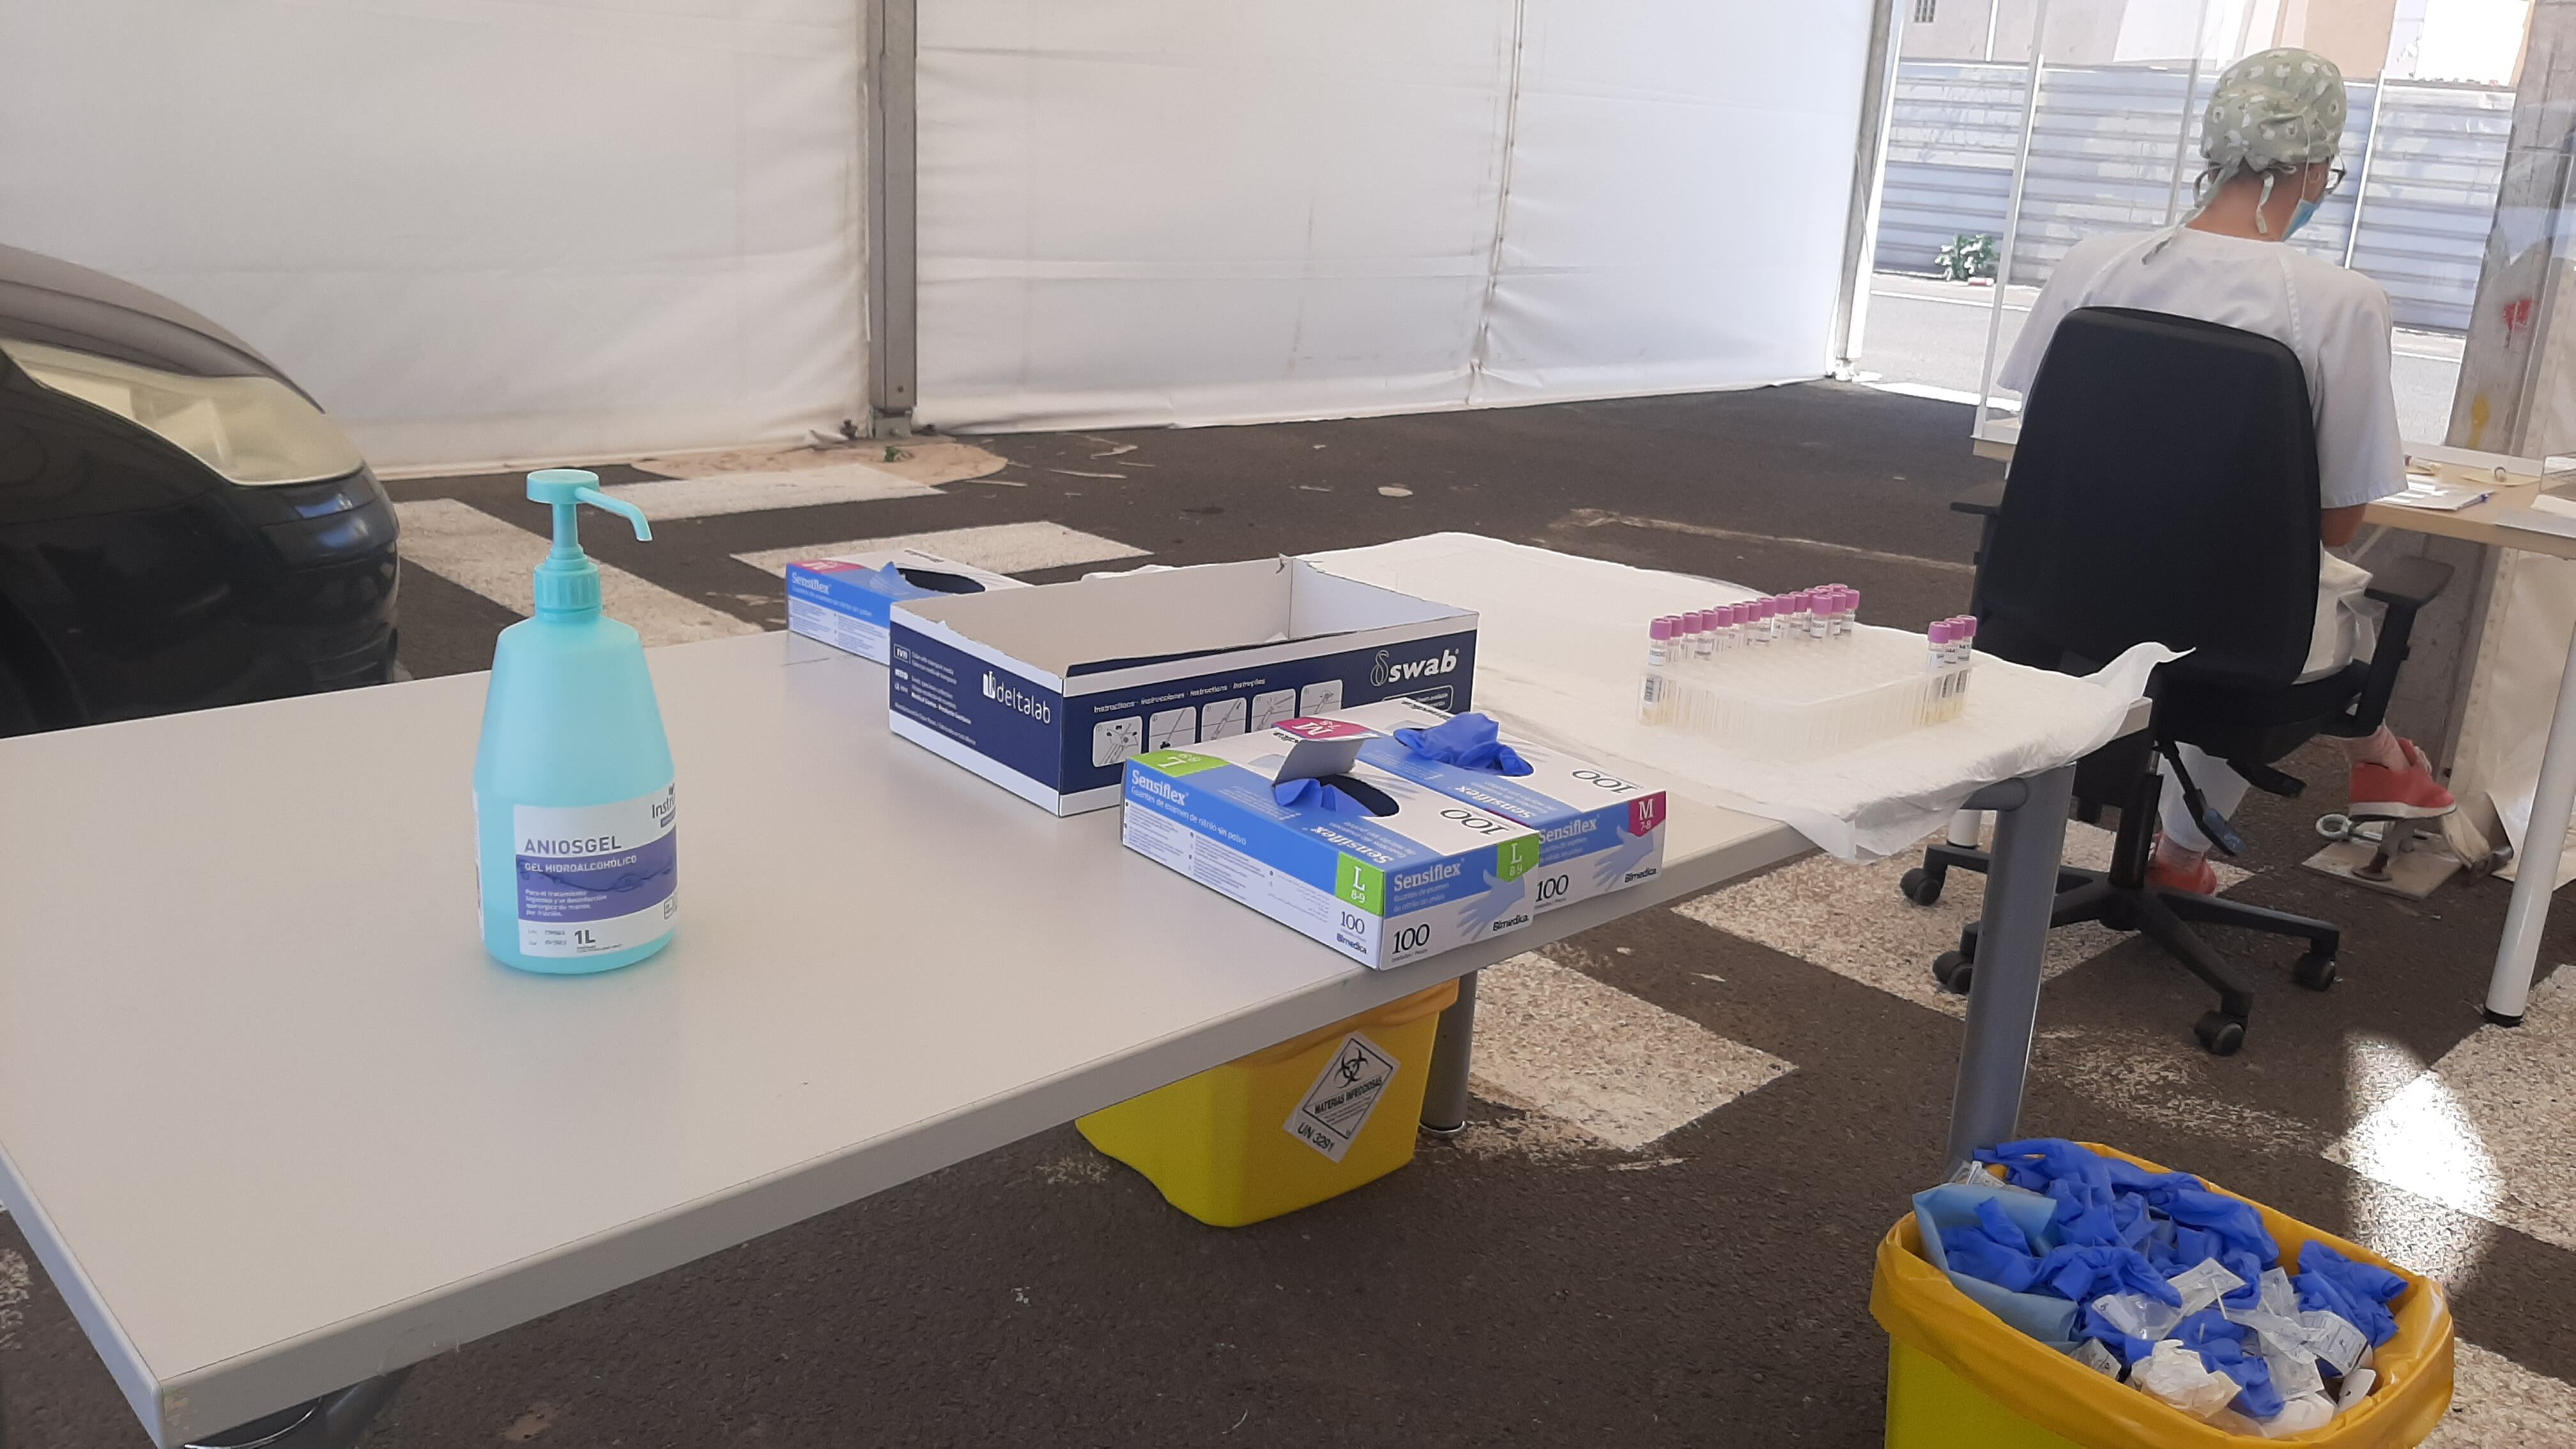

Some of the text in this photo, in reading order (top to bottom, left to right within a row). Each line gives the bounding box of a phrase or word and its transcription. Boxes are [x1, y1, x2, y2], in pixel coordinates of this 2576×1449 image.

[997, 682, 1051, 724] deltalab
[1131, 770, 1185, 806] Sensiflex
[1572, 770, 1638, 793] 100
[1441, 809, 1509, 835] 100
[1639, 799, 1653, 820] M
[1539, 818, 1597, 844] Sensiflex
[525, 836, 621, 855] ANIOSGEL
[1510, 843, 1522, 864] L
[525, 855, 636, 873] GEL HIDROALCOHÓLICO
[1353, 866, 1365, 891] L
[1394, 863, 1461, 892] Sensiflex
[1535, 874, 1569, 902] 100
[1351, 890, 1365, 903] 8-9
[1340, 911, 1365, 934] 100
[574, 930, 596, 945] 1L
[1392, 924, 1430, 954] 100
[1298, 1122, 1335, 1152] UN 3291
